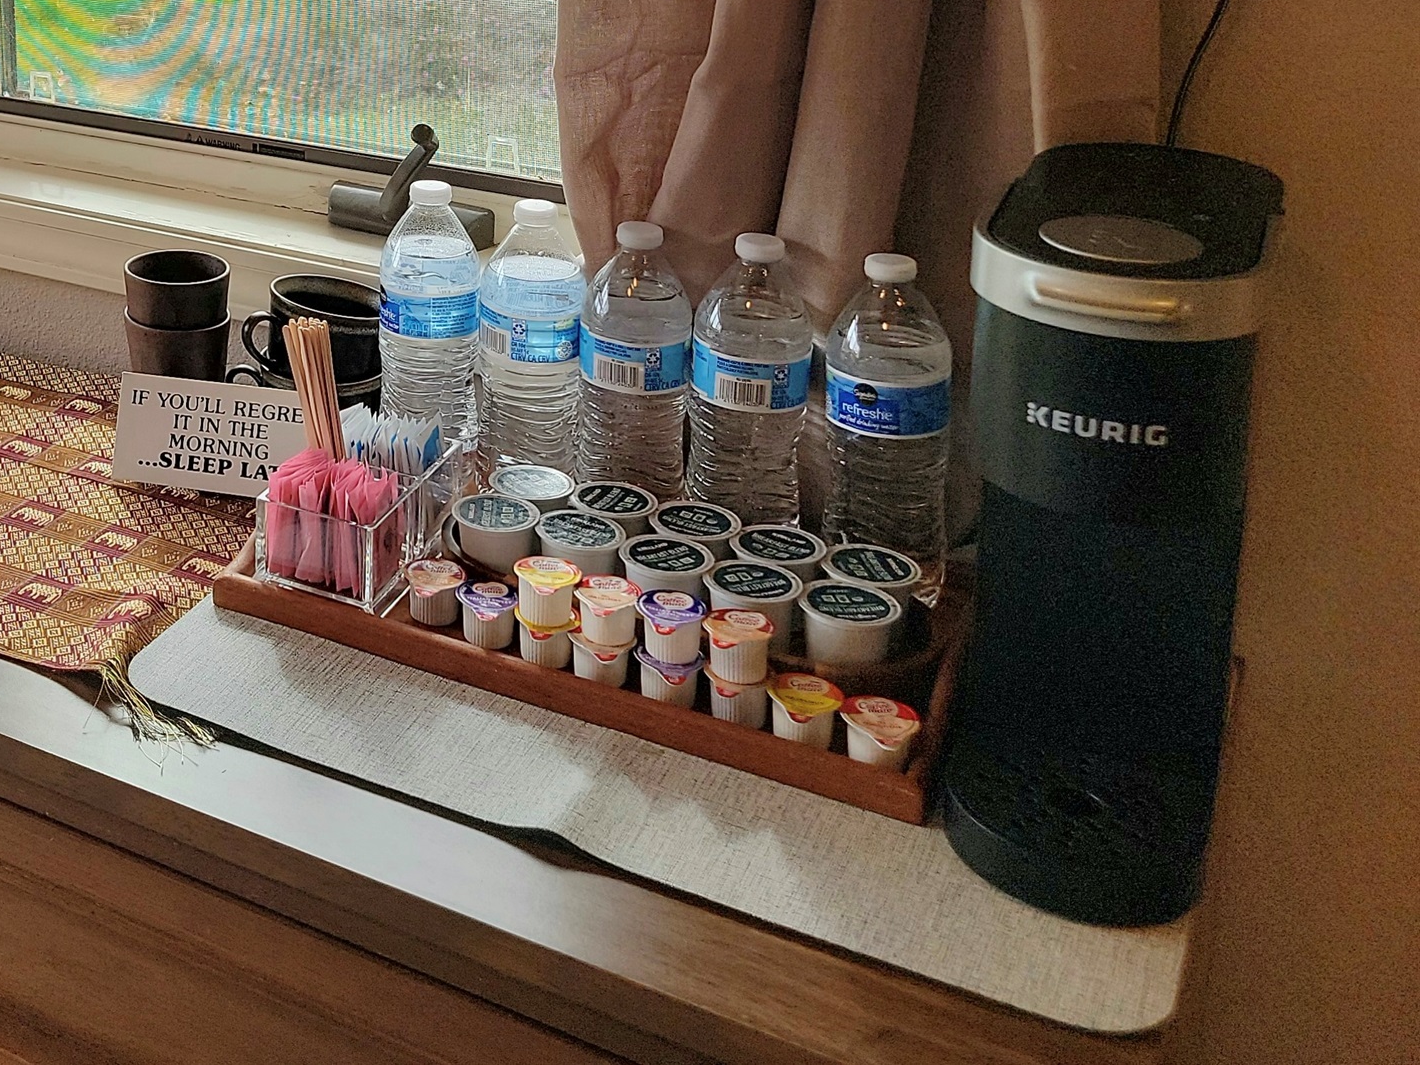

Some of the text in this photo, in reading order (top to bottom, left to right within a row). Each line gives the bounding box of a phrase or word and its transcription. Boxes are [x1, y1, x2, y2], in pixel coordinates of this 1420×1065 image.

[131, 389, 304, 424] IF YOU'LL REGRE
[173, 413, 269, 440] IT IN THE
[1026, 402, 1169, 446] KEURIG
[168, 433, 270, 460] MORNING
[240, 461, 281, 481] LAT
[656, 595, 687, 604] Coffee
